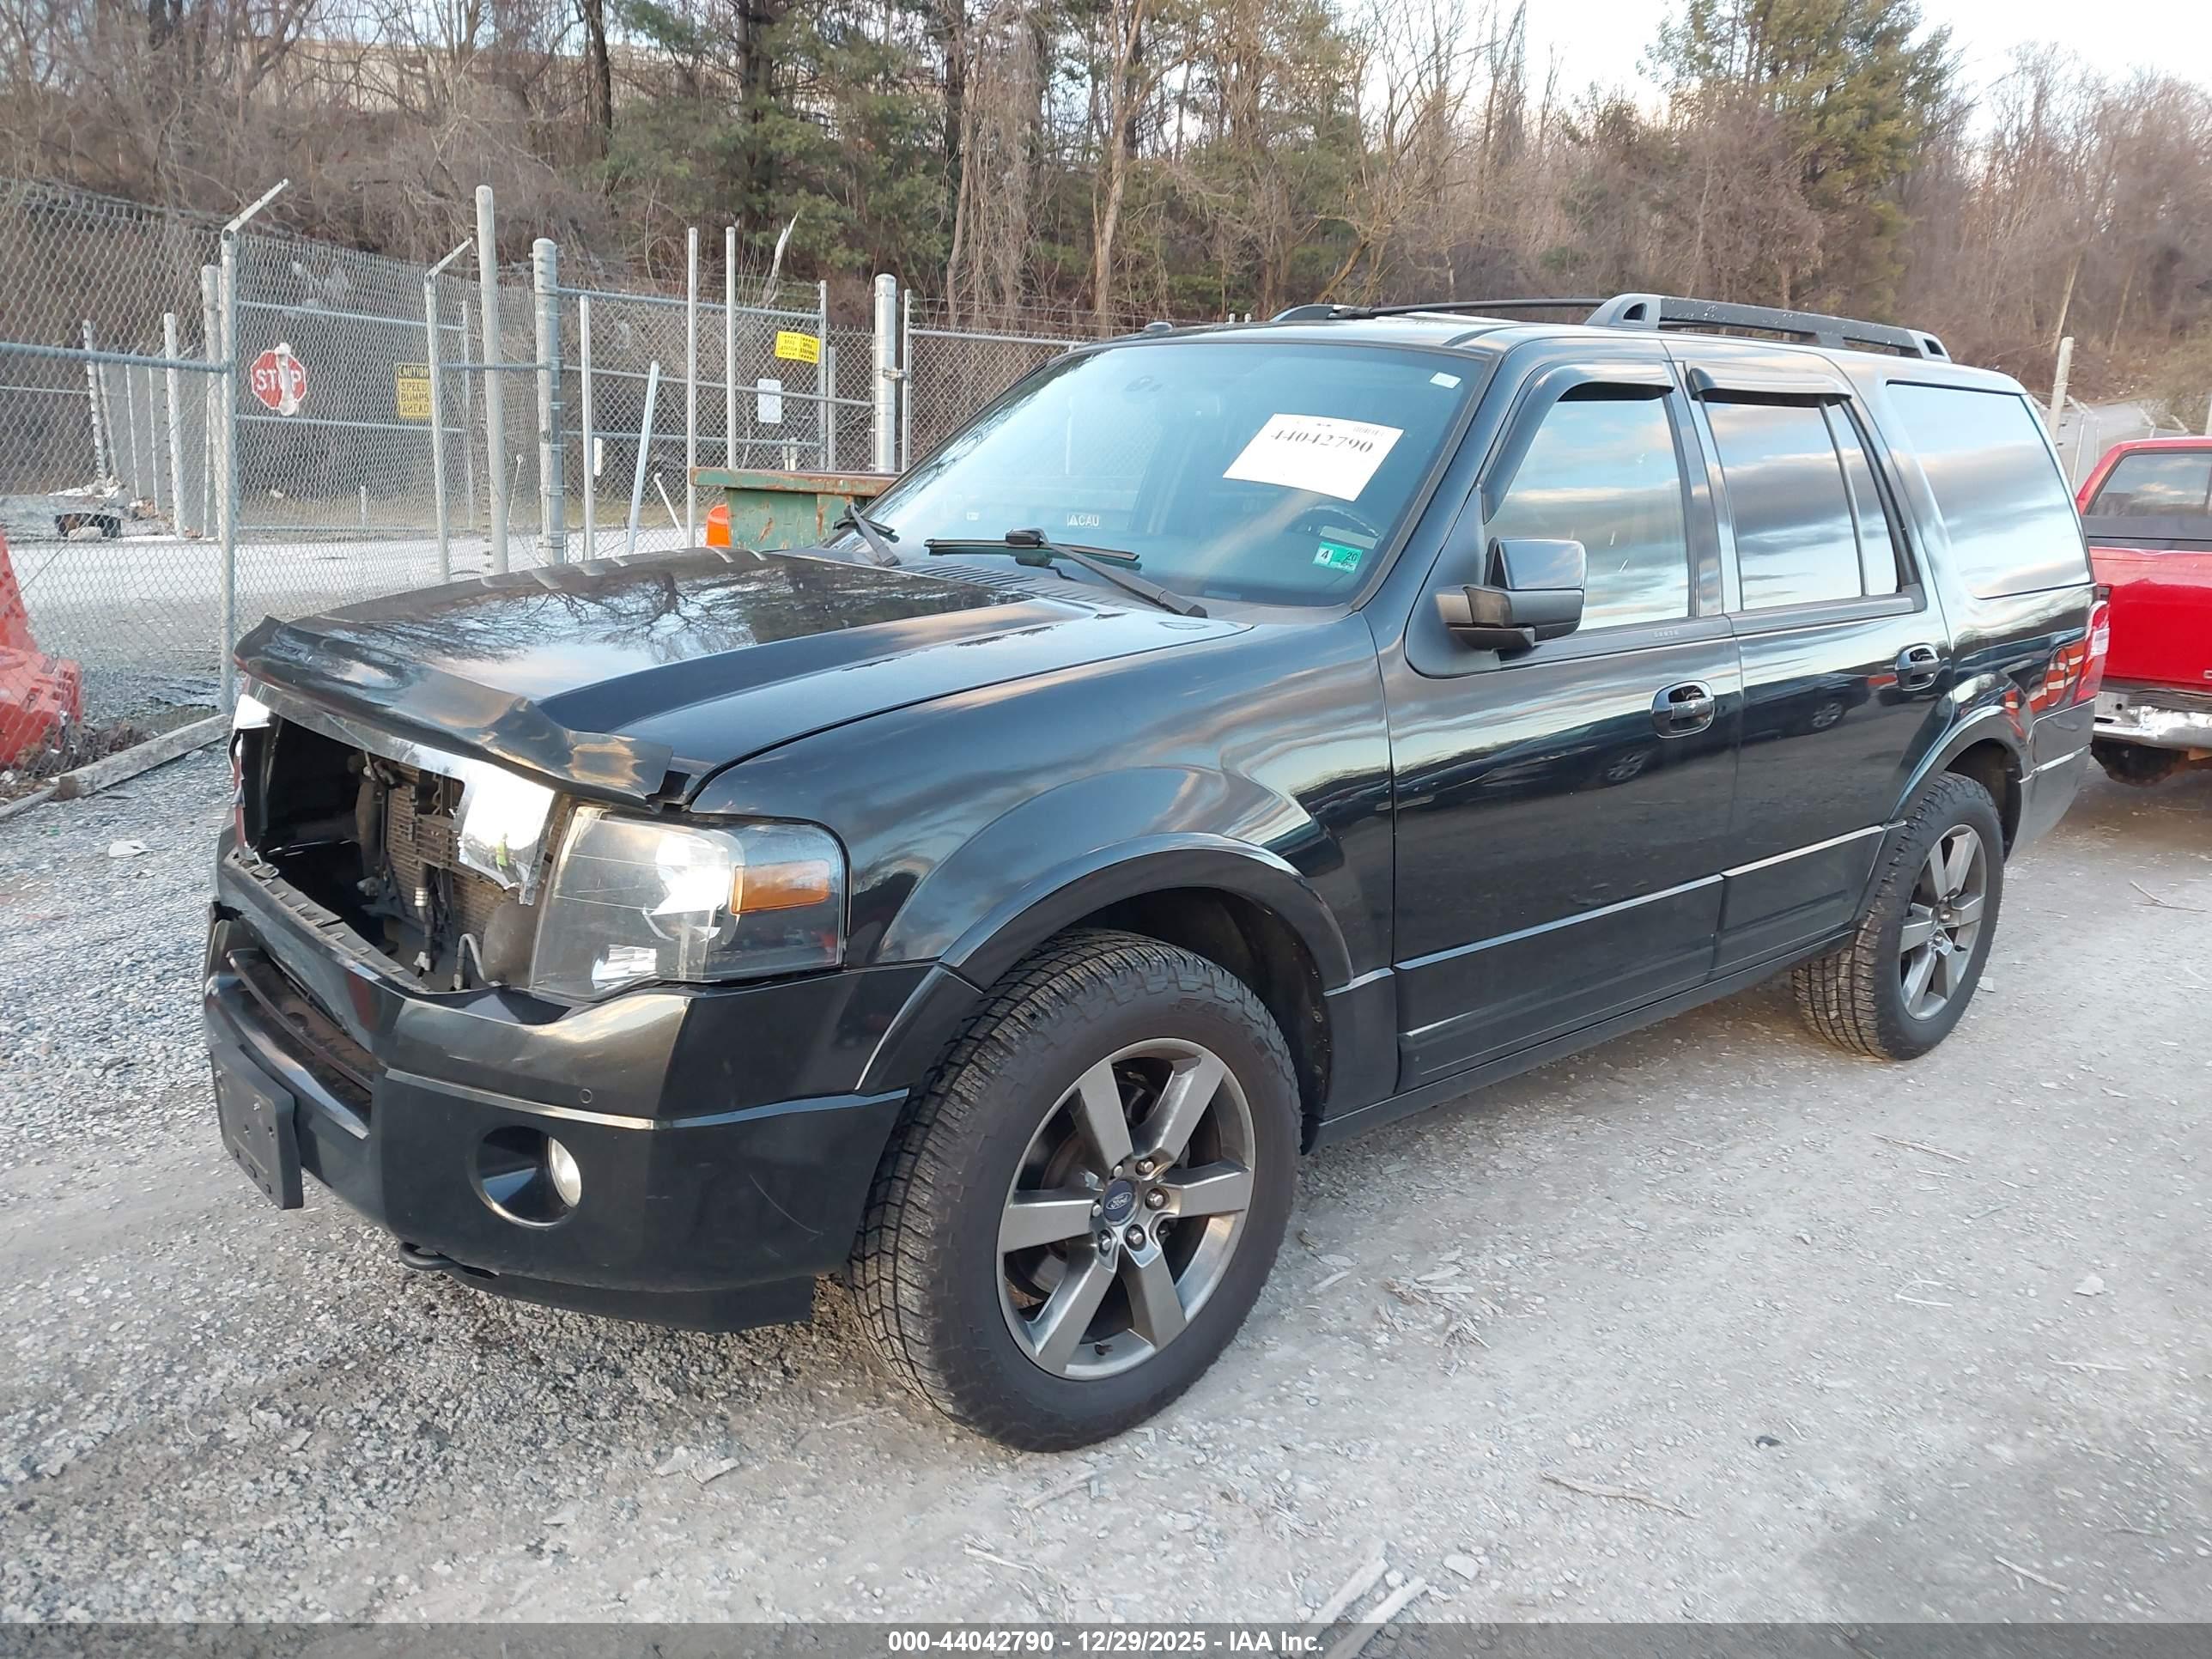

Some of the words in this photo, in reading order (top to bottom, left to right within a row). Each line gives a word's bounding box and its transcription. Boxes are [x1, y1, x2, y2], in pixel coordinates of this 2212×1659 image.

[398, 365, 429, 377] CAUTION
[401, 392, 429, 402] BUMPS
[1271, 429, 1374, 453] 44042790
